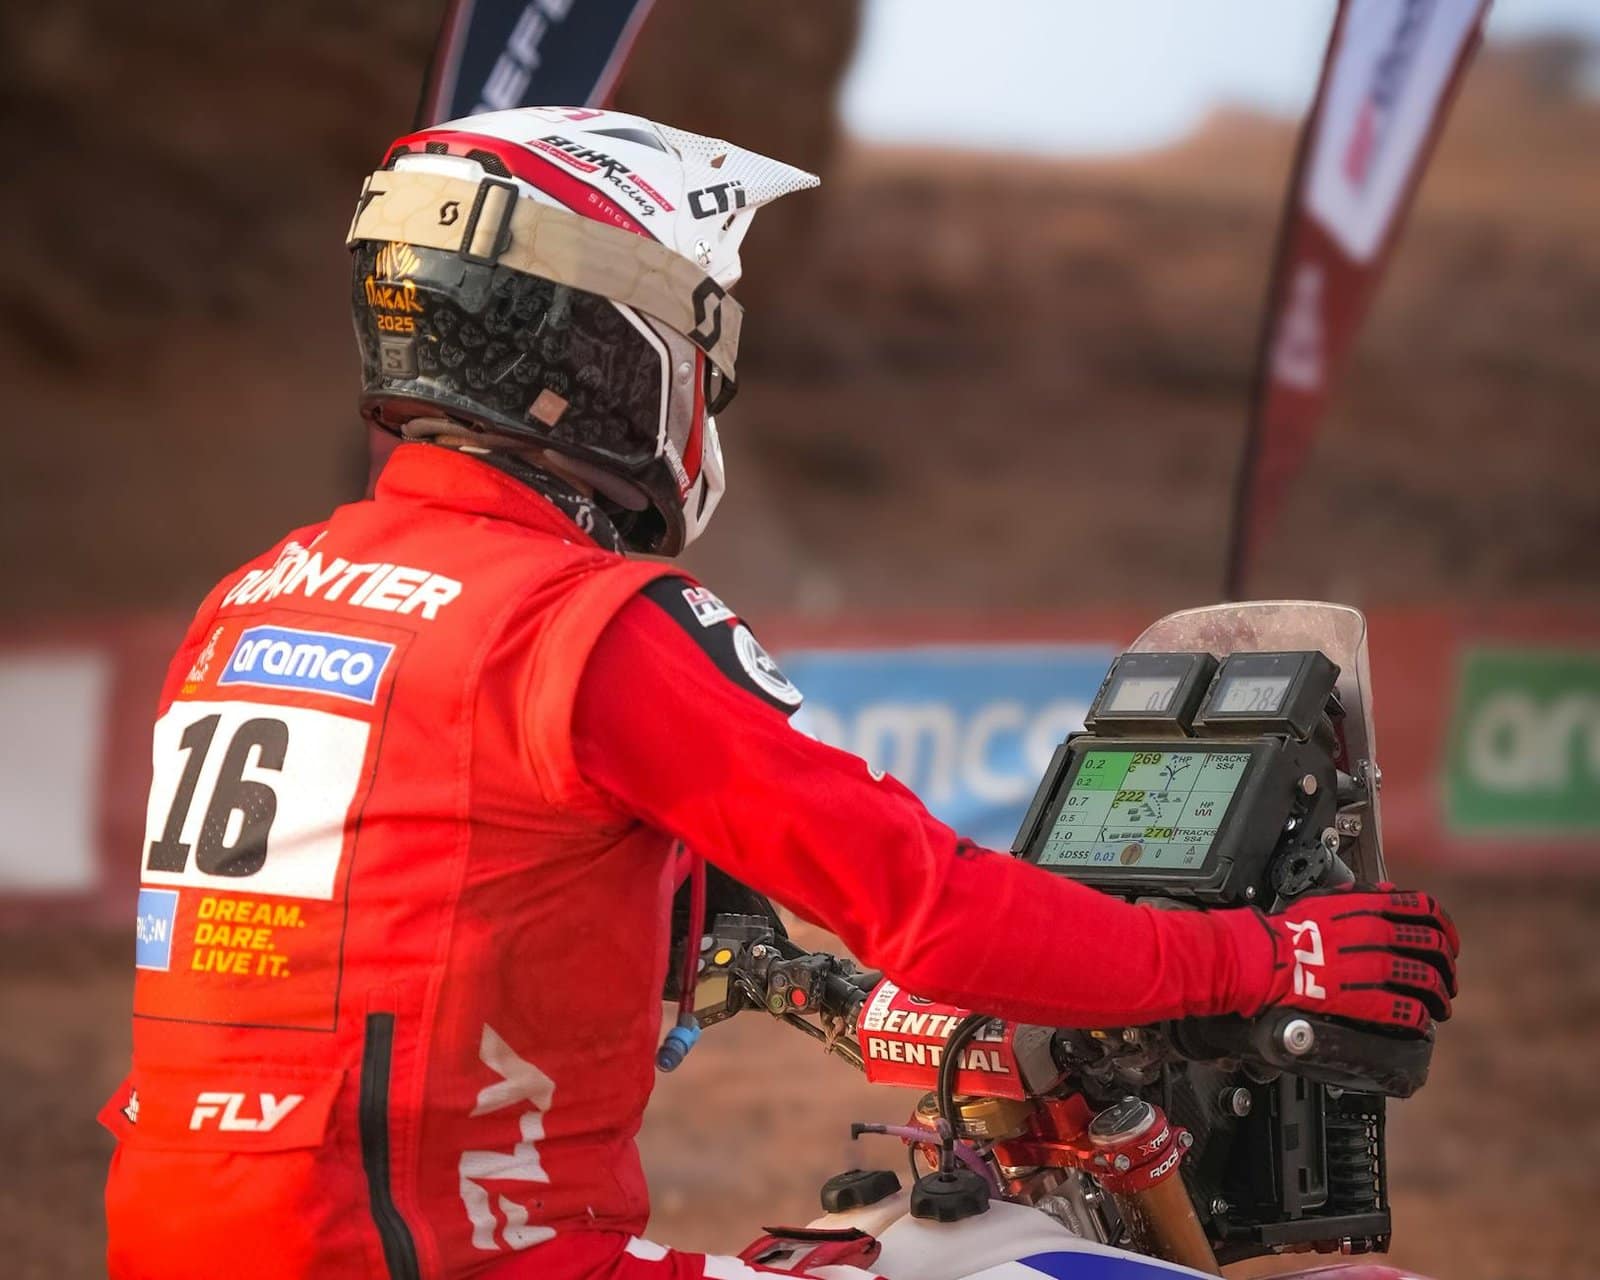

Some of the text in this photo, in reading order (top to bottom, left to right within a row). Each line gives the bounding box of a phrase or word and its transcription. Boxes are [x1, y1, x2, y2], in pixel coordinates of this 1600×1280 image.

[377, 314, 415, 332] 2025
[232, 638, 374, 686] aramco
[1085, 759, 1106, 769] 0.2
[1133, 753, 1161, 765] 269
[1178, 755, 1193, 764] HP
[1216, 762, 1235, 770] SS4
[1076, 778, 1092, 786] 0.2
[146, 714, 289, 877] 16
[1117, 791, 1145, 802] 222
[1068, 796, 1089, 807] 0.7
[1199, 801, 1214, 809] HP
[1060, 814, 1076, 822] 0.5
[1054, 831, 1072, 840] 1.0
[1143, 827, 1173, 838] 270
[1178, 829, 1217, 837] TRACKS
[196, 896, 305, 928] DREAM.
[194, 922, 275, 950] DARE.
[190, 948, 291, 978] LIVE IT.
[1284, 919, 1327, 1000] FLY
[189, 1091, 305, 1131] FLY
